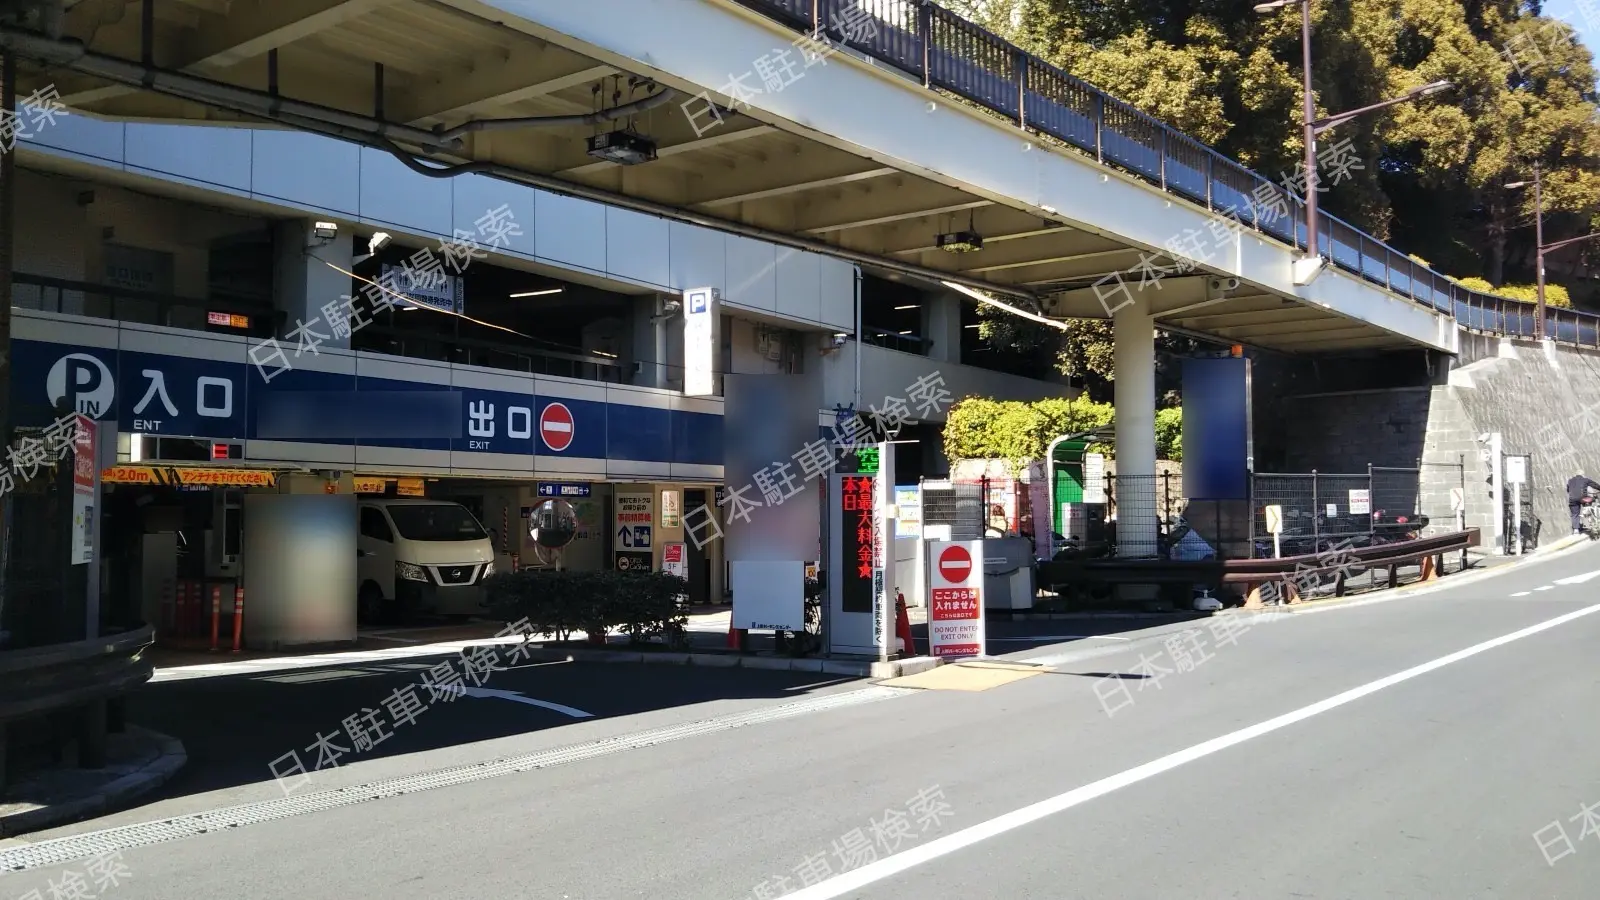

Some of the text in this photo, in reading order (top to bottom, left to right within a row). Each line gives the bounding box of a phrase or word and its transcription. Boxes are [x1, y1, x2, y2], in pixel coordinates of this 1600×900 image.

[132, 369, 234, 418] 入口
[80, 399, 99, 414] IN
[133, 419, 162, 431] ENT
[468, 400, 531, 440] 出口
[469, 440, 490, 450] EXIT
[117, 468, 149, 482] 2.0m
[182, 470, 267, 484] アンテナを下げてください
[842, 477, 857, 510] 本日
[935, 591, 977, 600] ここからは
[935, 601, 977, 610] 入れません
